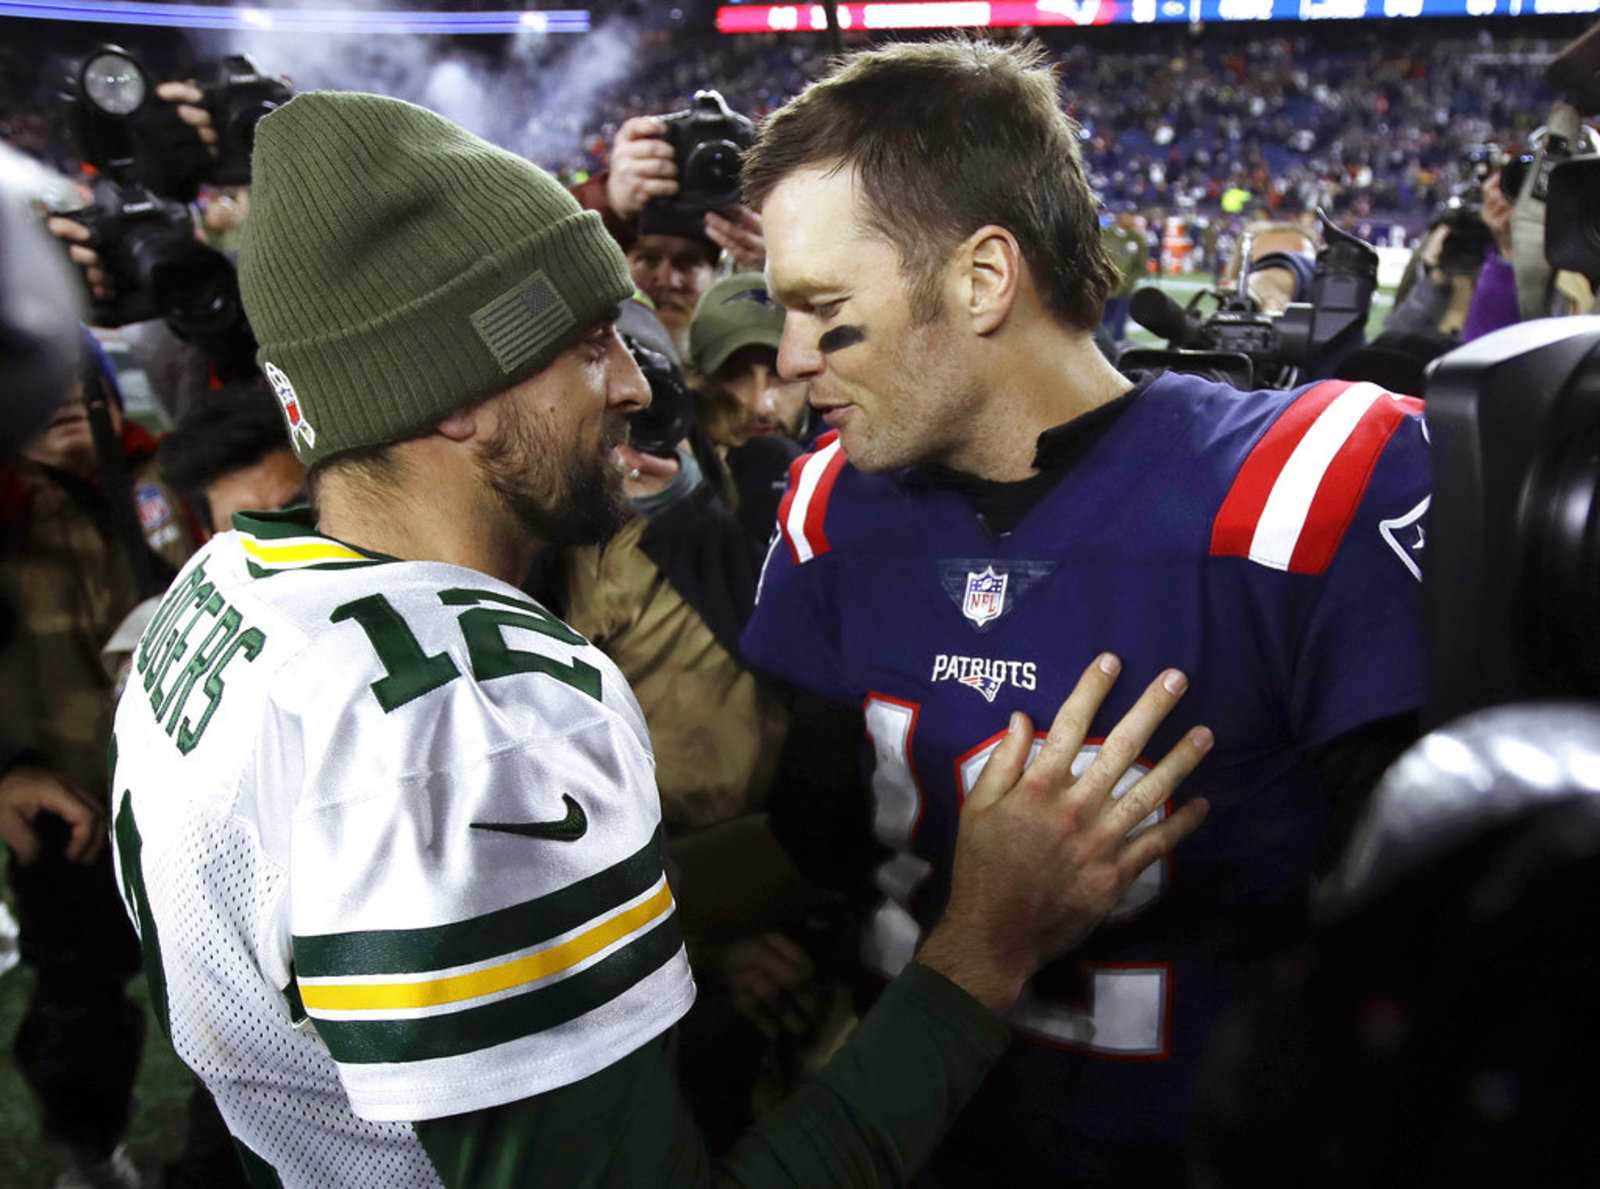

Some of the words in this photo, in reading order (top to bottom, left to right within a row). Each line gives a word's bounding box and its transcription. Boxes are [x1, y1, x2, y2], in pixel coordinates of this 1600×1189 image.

[970, 592, 998, 613] NFL
[329, 587, 603, 714] 12
[931, 654, 1037, 690] PATRIOTS
